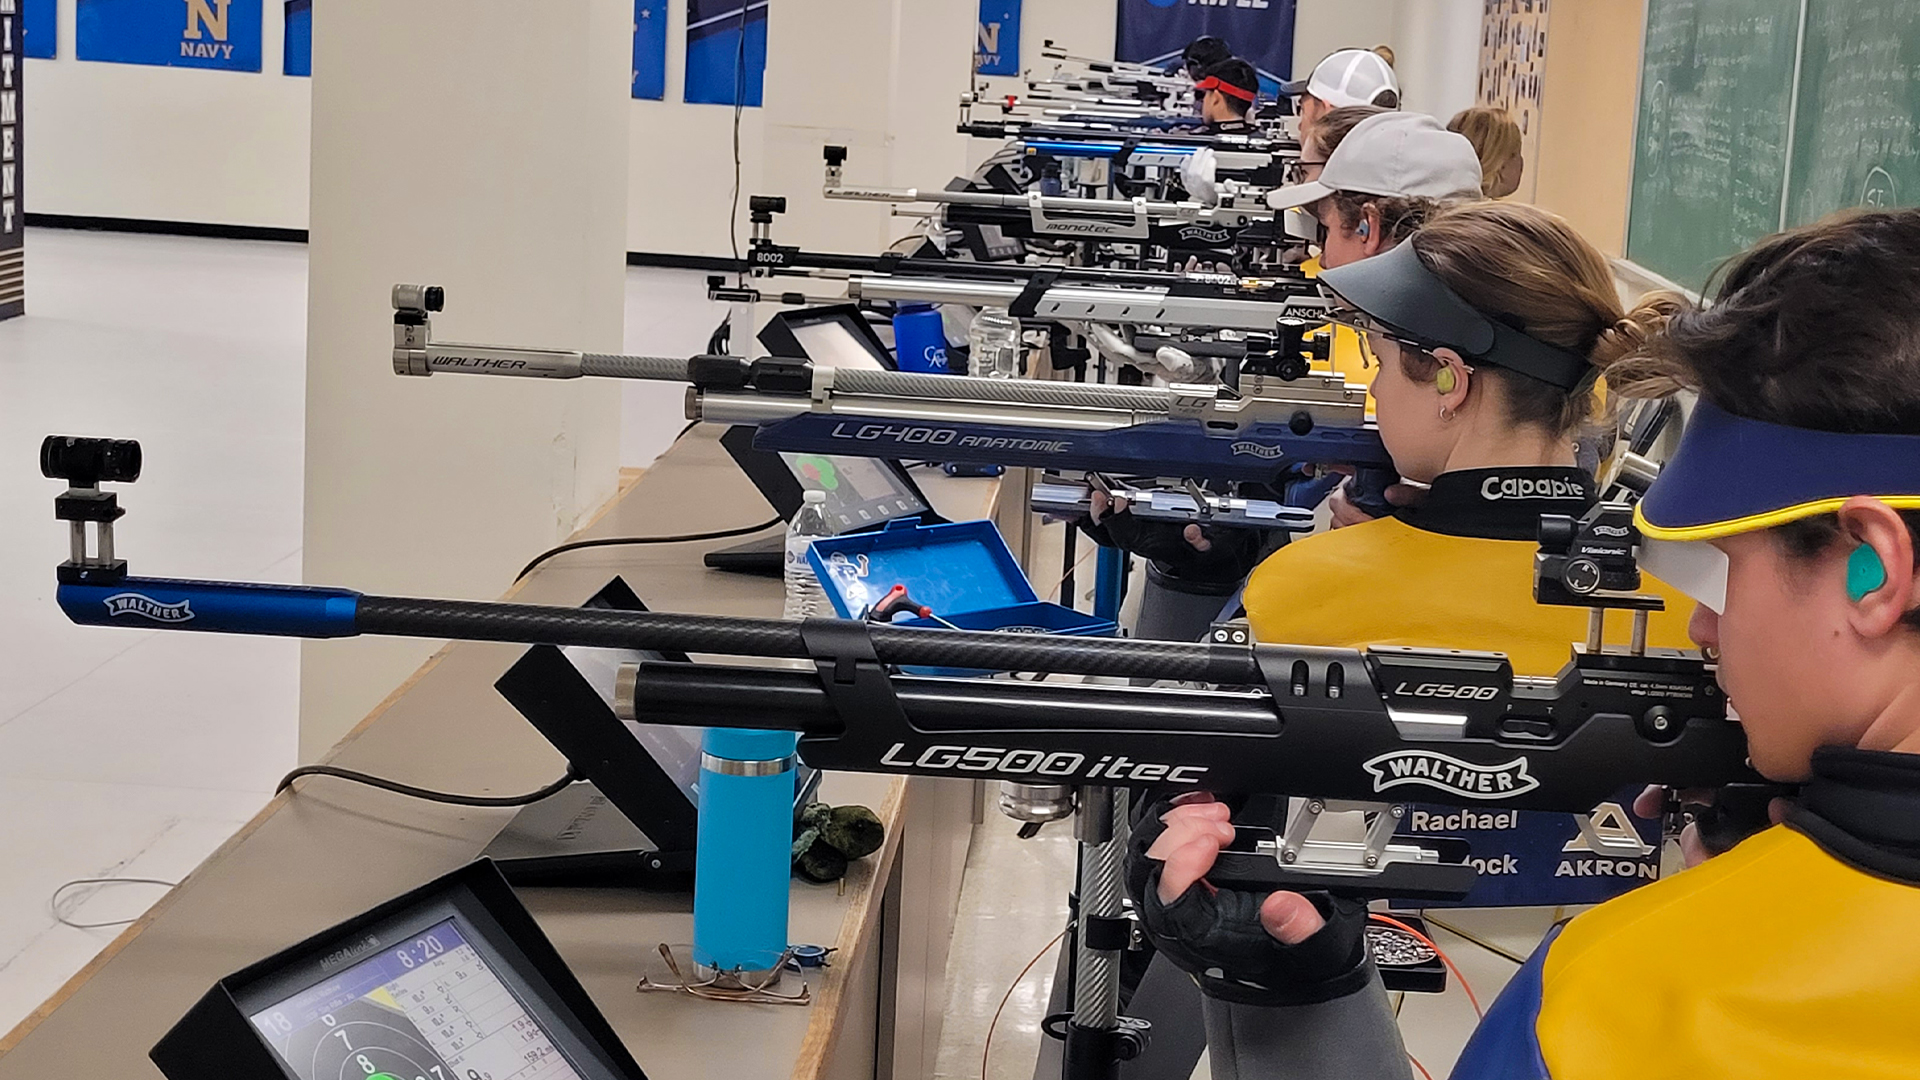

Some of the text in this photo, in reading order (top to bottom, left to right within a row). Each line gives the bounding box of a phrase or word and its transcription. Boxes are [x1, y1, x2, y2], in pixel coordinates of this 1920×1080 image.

[183, 0, 232, 41] N
[180, 42, 234, 60] NAVY
[1046, 222, 1118, 235] monotec
[756, 252, 784, 264] 8002
[432, 355, 527, 370] WALTHER
[831, 422, 1074, 452] LG400 ANATOMIC
[1481, 476, 1586, 500] Capapie
[115, 597, 182, 619] WALTHER
[1396, 681, 1500, 701] LG500
[880, 742, 1210, 784] LG500 itec
[1387, 757, 1514, 792] WALTHER
[1411, 809, 1519, 832] Rachael
[1470, 854, 1519, 875] ock
[1554, 859, 1658, 880] AKRON
[397, 935, 444, 968] 8:20
[264, 1012, 292, 1036] 18
[334, 1029, 353, 1051] 7
[356, 1054, 376, 1075] 8
